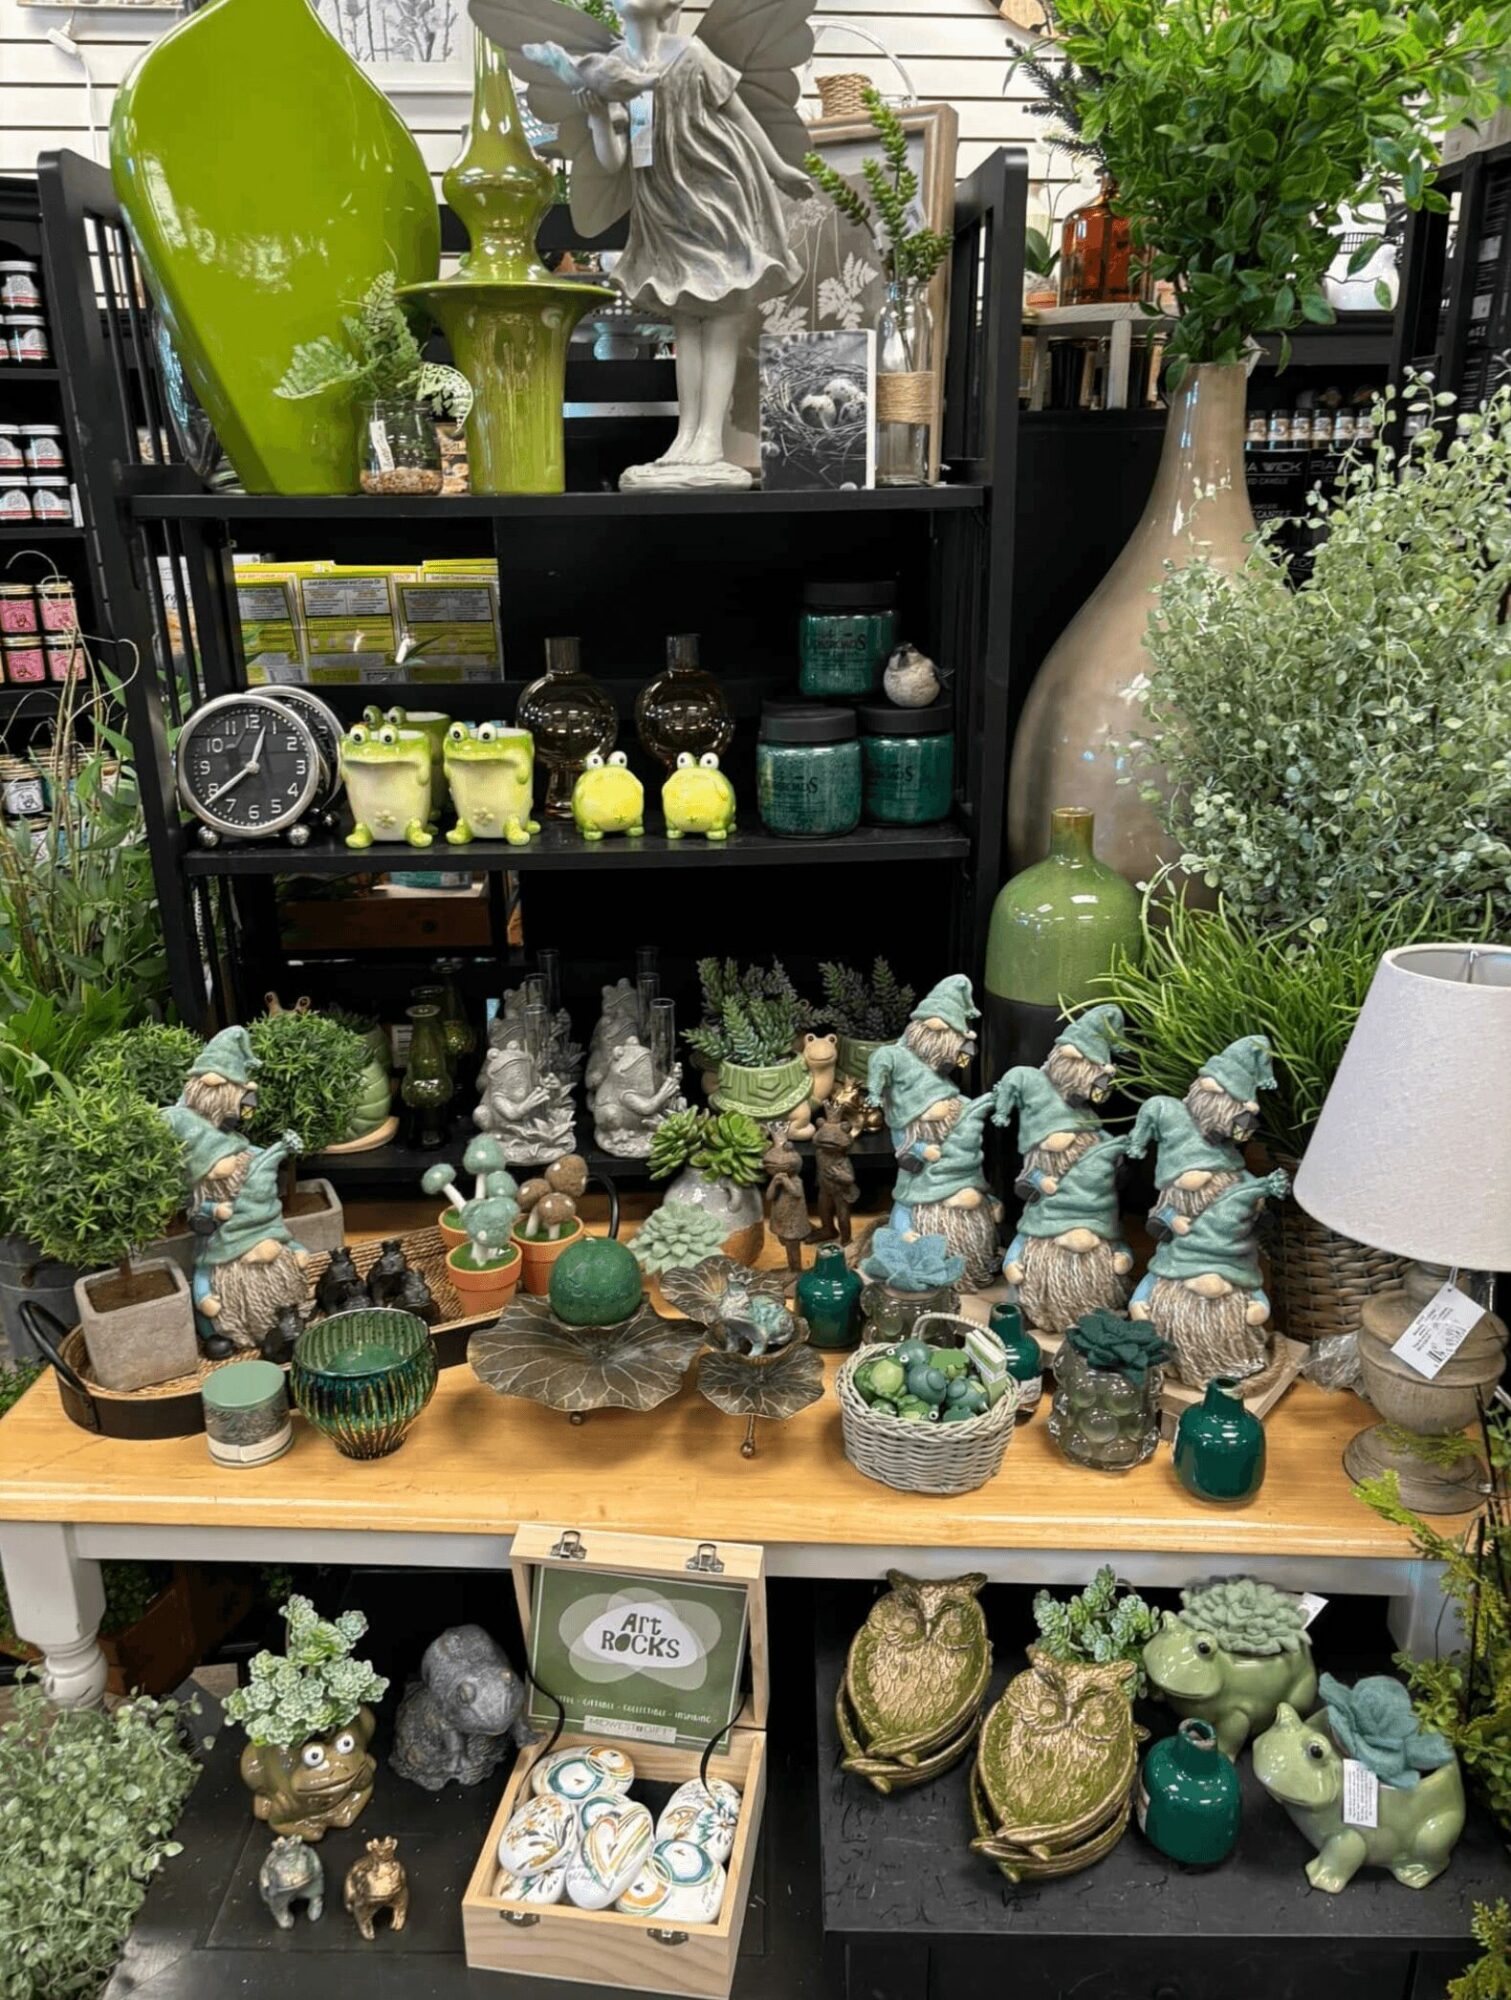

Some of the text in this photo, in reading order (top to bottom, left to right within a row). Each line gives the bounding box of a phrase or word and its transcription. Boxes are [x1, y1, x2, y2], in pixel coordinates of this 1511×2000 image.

[225, 720, 236, 735] 11
[245, 714, 260, 729] 12
[272, 720, 277, 735] 1
[206, 738, 223, 753] 10
[286, 736, 298, 751] 2
[200, 760, 211, 775] 9
[296, 760, 306, 775] 3
[287, 783, 299, 797] 4
[225, 799, 237, 813] 7
[248, 805, 260, 820] 6
[271, 799, 282, 814] 5
[620, 1612, 662, 1636] Art
[601, 1630, 680, 1659] ROCKS
[675, 1711, 712, 1724] INSPIRING
